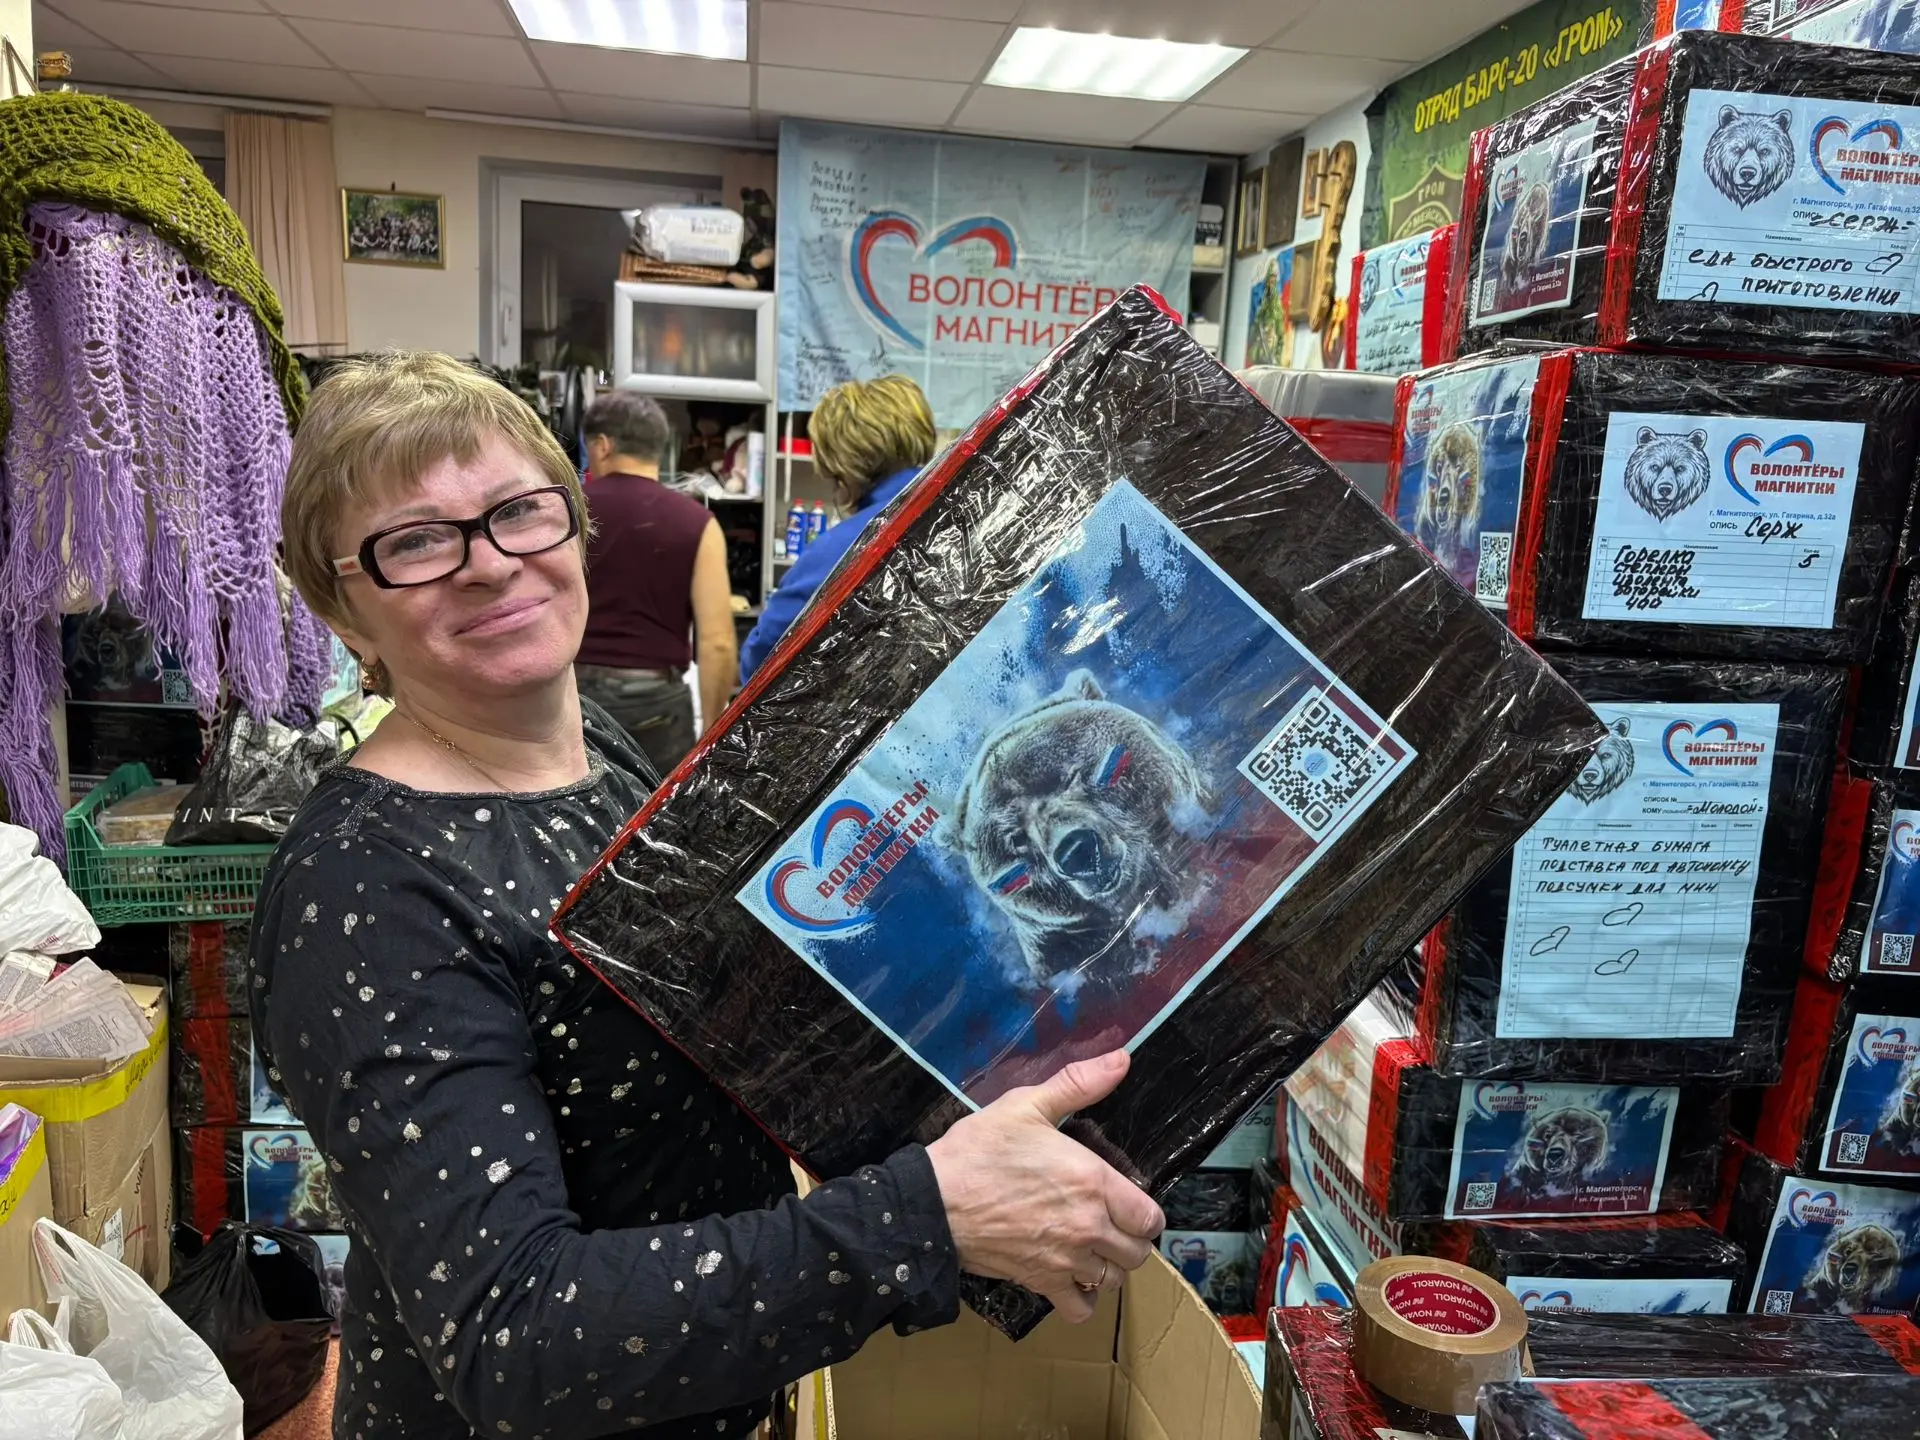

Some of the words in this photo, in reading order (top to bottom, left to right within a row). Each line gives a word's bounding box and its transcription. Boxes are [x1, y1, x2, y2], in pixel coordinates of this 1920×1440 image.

[1414, 81, 1462, 134] ОТРЯД
[1463, 43, 1539, 109] БАРС-20
[1542, 6, 1624, 69] «ГРОМ»
[1837, 148, 1920, 167] ВОЛОНТЁР
[1418, 181, 1445, 203] ГРОМ
[908, 272, 1125, 316] ВОЛОНТЁР
[934, 314, 1077, 349] МАГНИТ
[1750, 462, 1845, 479] ВОЛОНТЁРЫ
[1754, 480, 1836, 495] МАГНИТКИ
[1769, 513, 1780, 521] ул.
[1781, 511, 1816, 522] Гагарина,
[1816, 513, 1837, 521] д.32а
[1744, 515, 1803, 545] Серж
[1798, 553, 1820, 569] 5
[1684, 741, 1765, 753] ВОЛОНТЁРЫ
[1688, 756, 1757, 766] МАГНИТКИ
[815, 780, 929, 899] ВОЛОНТЁРЫ
[841, 805, 940, 908] МАГНИТКИ
[1631, 861, 1660, 874] ПОД
[1411, 1279, 1460, 1290] NOVAROLL
[1433, 1293, 1479, 1312] NOVAROLL
